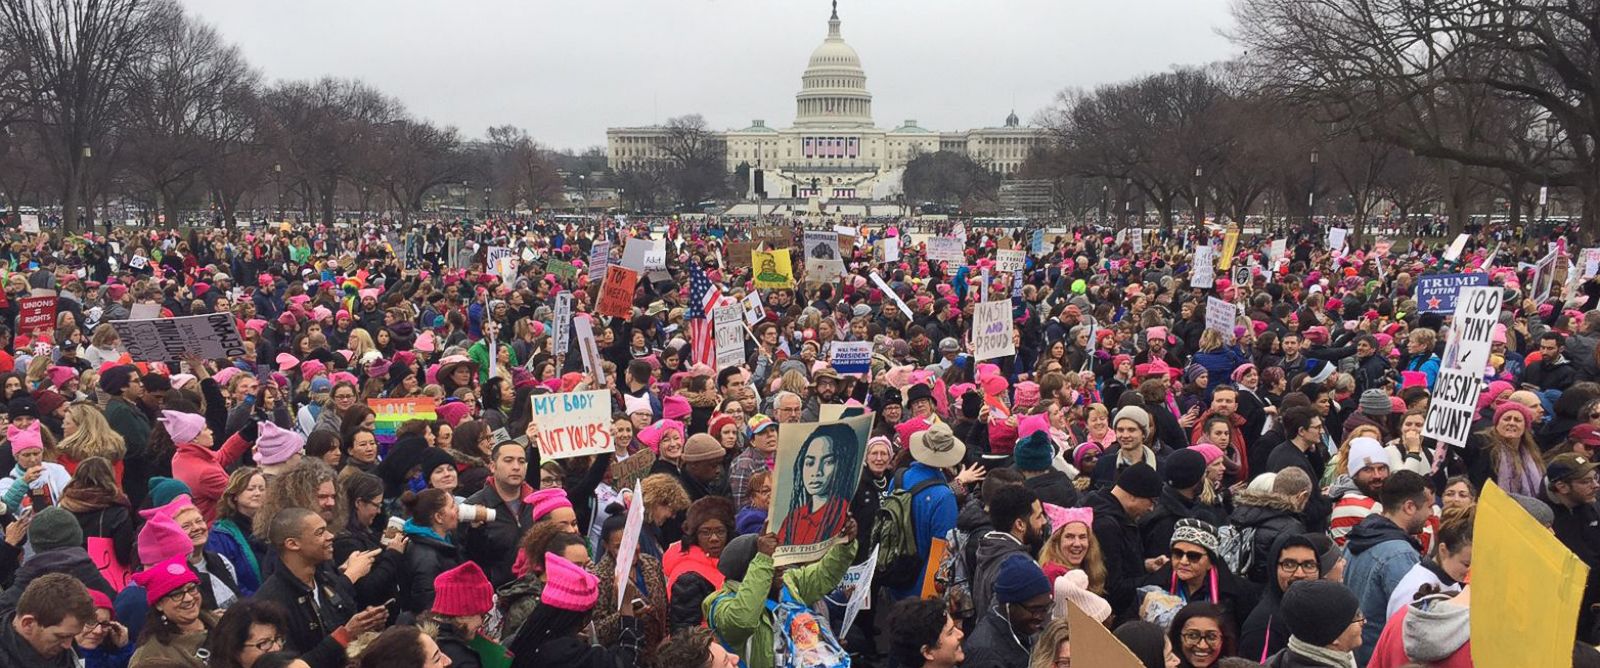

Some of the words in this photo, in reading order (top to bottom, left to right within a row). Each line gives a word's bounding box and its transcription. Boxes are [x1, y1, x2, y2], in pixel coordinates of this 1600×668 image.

[1421, 276, 1479, 288] TRUMP
[1423, 287, 1456, 296] PUTIN
[22, 300, 54, 309] UNIONS
[25, 314, 51, 324] RIGHTS
[986, 321, 1003, 335] AND
[208, 314, 246, 357] DEMAND
[1463, 317, 1496, 342] TINY
[976, 334, 1008, 354] PROUD
[1433, 371, 1482, 407] DOESN'T
[377, 402, 416, 416] LOVE
[534, 396, 556, 415] MY
[563, 393, 594, 412] BODY
[1425, 404, 1472, 442] COUNT
[537, 428, 564, 456] NOT
[566, 423, 610, 451] YOURS
